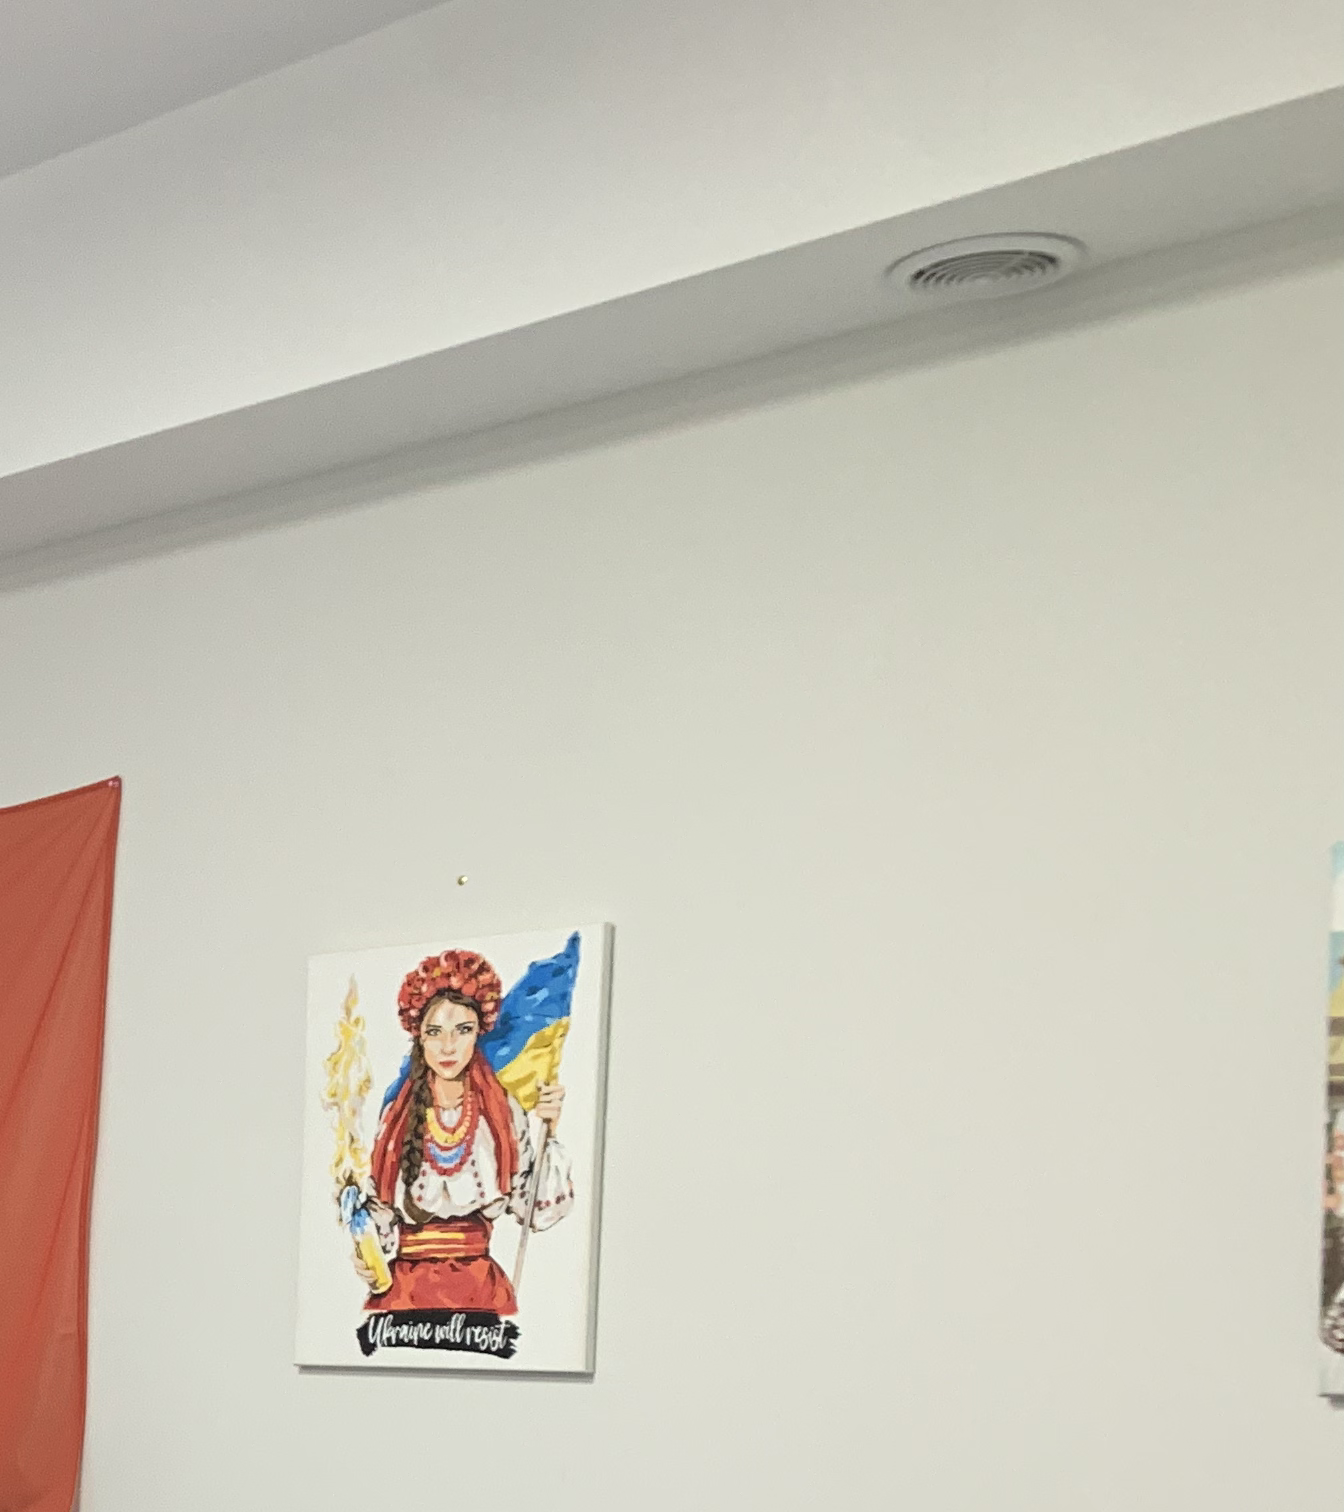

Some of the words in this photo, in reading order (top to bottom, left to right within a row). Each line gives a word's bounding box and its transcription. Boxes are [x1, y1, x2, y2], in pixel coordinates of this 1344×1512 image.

[368, 1313, 433, 1348] Ukraine
[434, 1312, 467, 1344] will
[466, 1322, 511, 1352] resist
